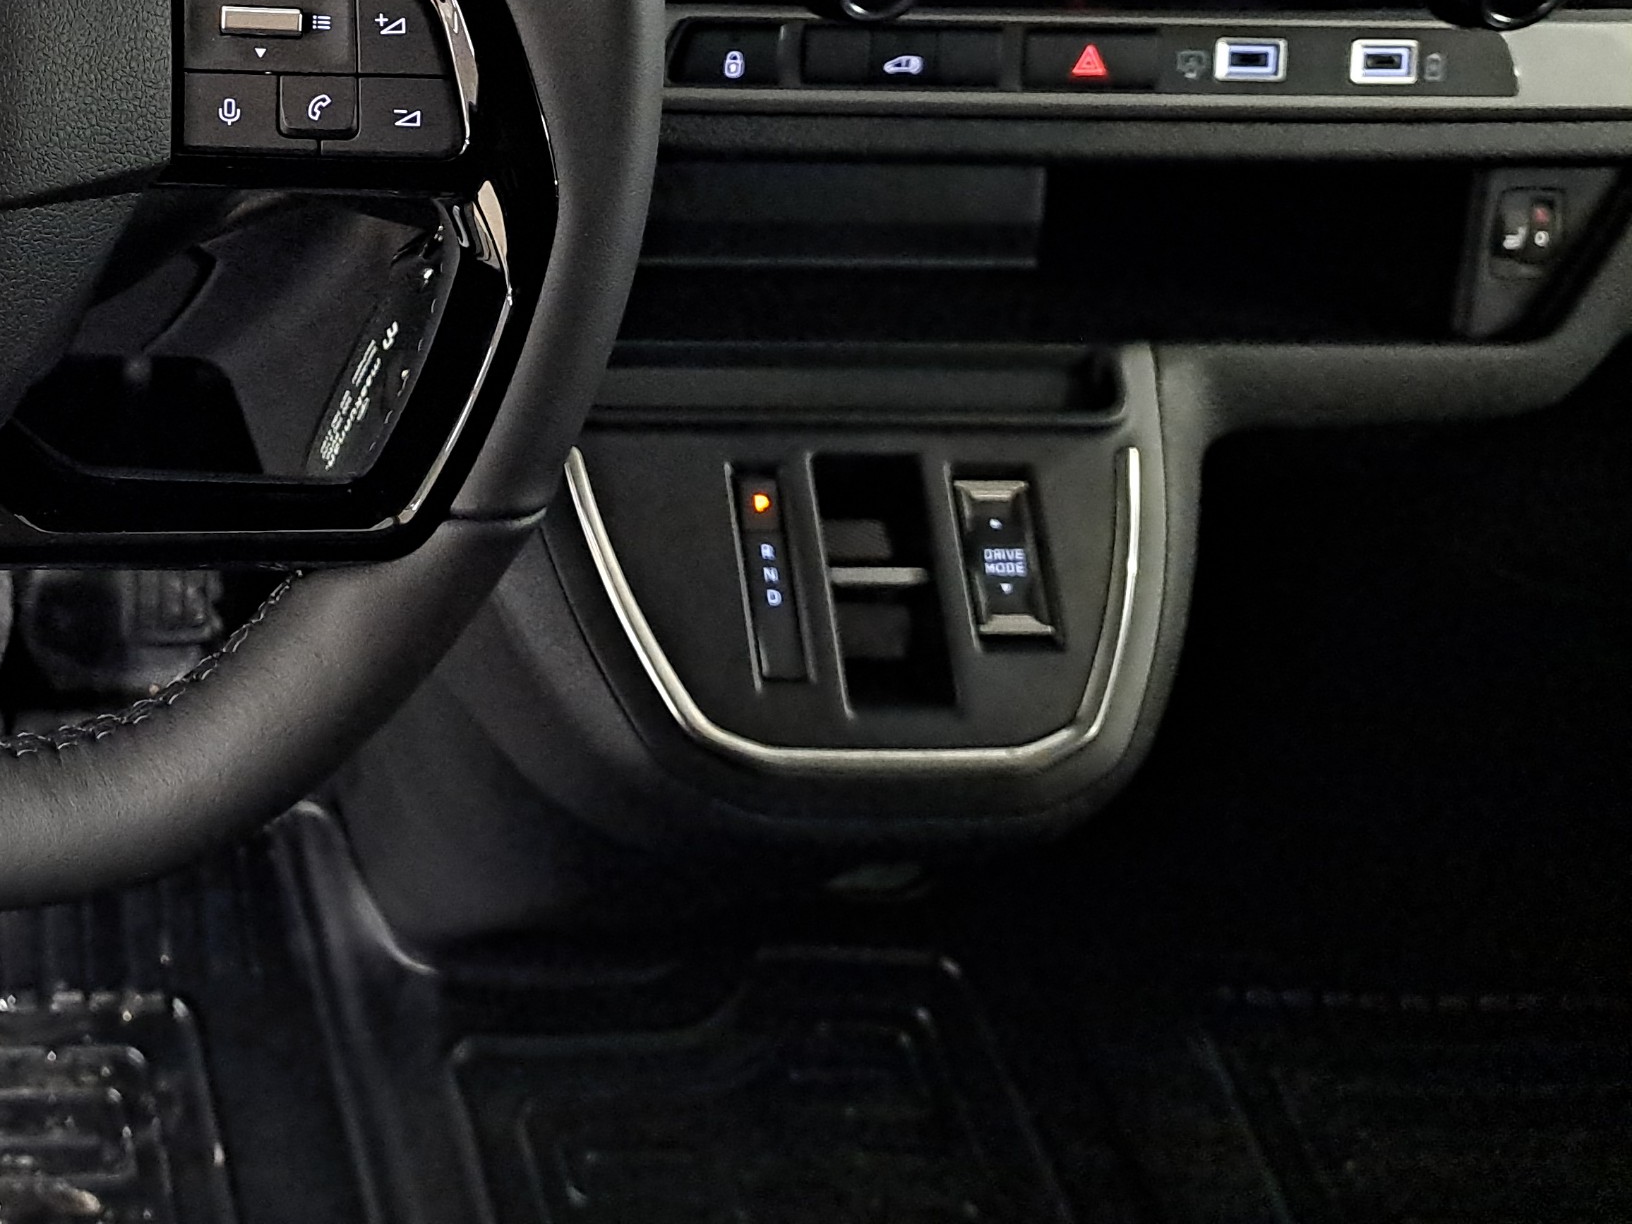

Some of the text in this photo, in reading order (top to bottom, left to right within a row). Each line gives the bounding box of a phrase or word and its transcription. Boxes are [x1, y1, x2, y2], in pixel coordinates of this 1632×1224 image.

[760, 543, 776, 561] R
[983, 547, 1027, 563] DRIVE
[763, 566, 779, 583] N
[984, 561, 1028, 576] MODE
[766, 589, 783, 607] D
